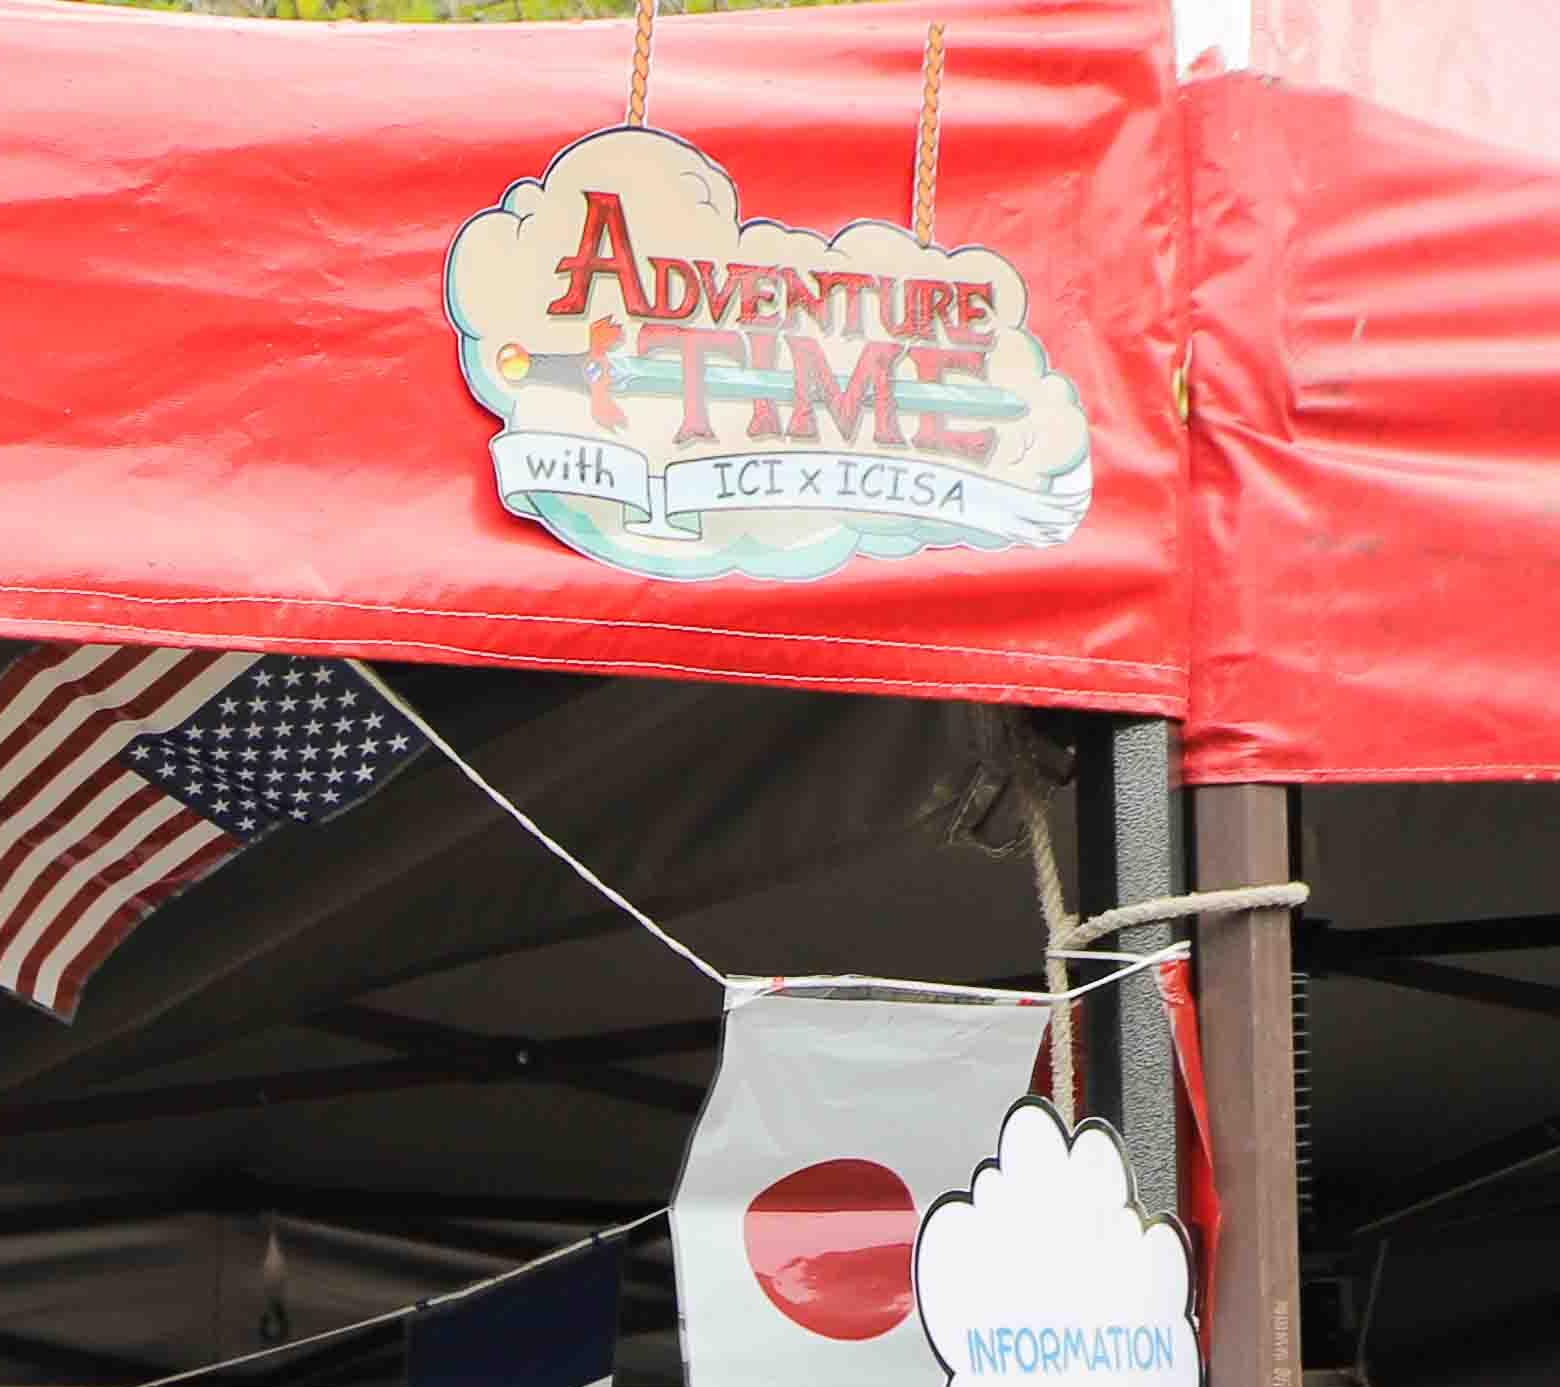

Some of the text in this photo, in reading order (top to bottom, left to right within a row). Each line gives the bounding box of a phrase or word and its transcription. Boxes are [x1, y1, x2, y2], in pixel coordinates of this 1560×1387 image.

[546, 191, 994, 350] ADVENTURE
[639, 323, 996, 462] TIME
[525, 451, 615, 488] with
[714, 463, 784, 499] ICI
[840, 466, 967, 514] ICISA
[967, 1326, 1175, 1375] INFORMATION
